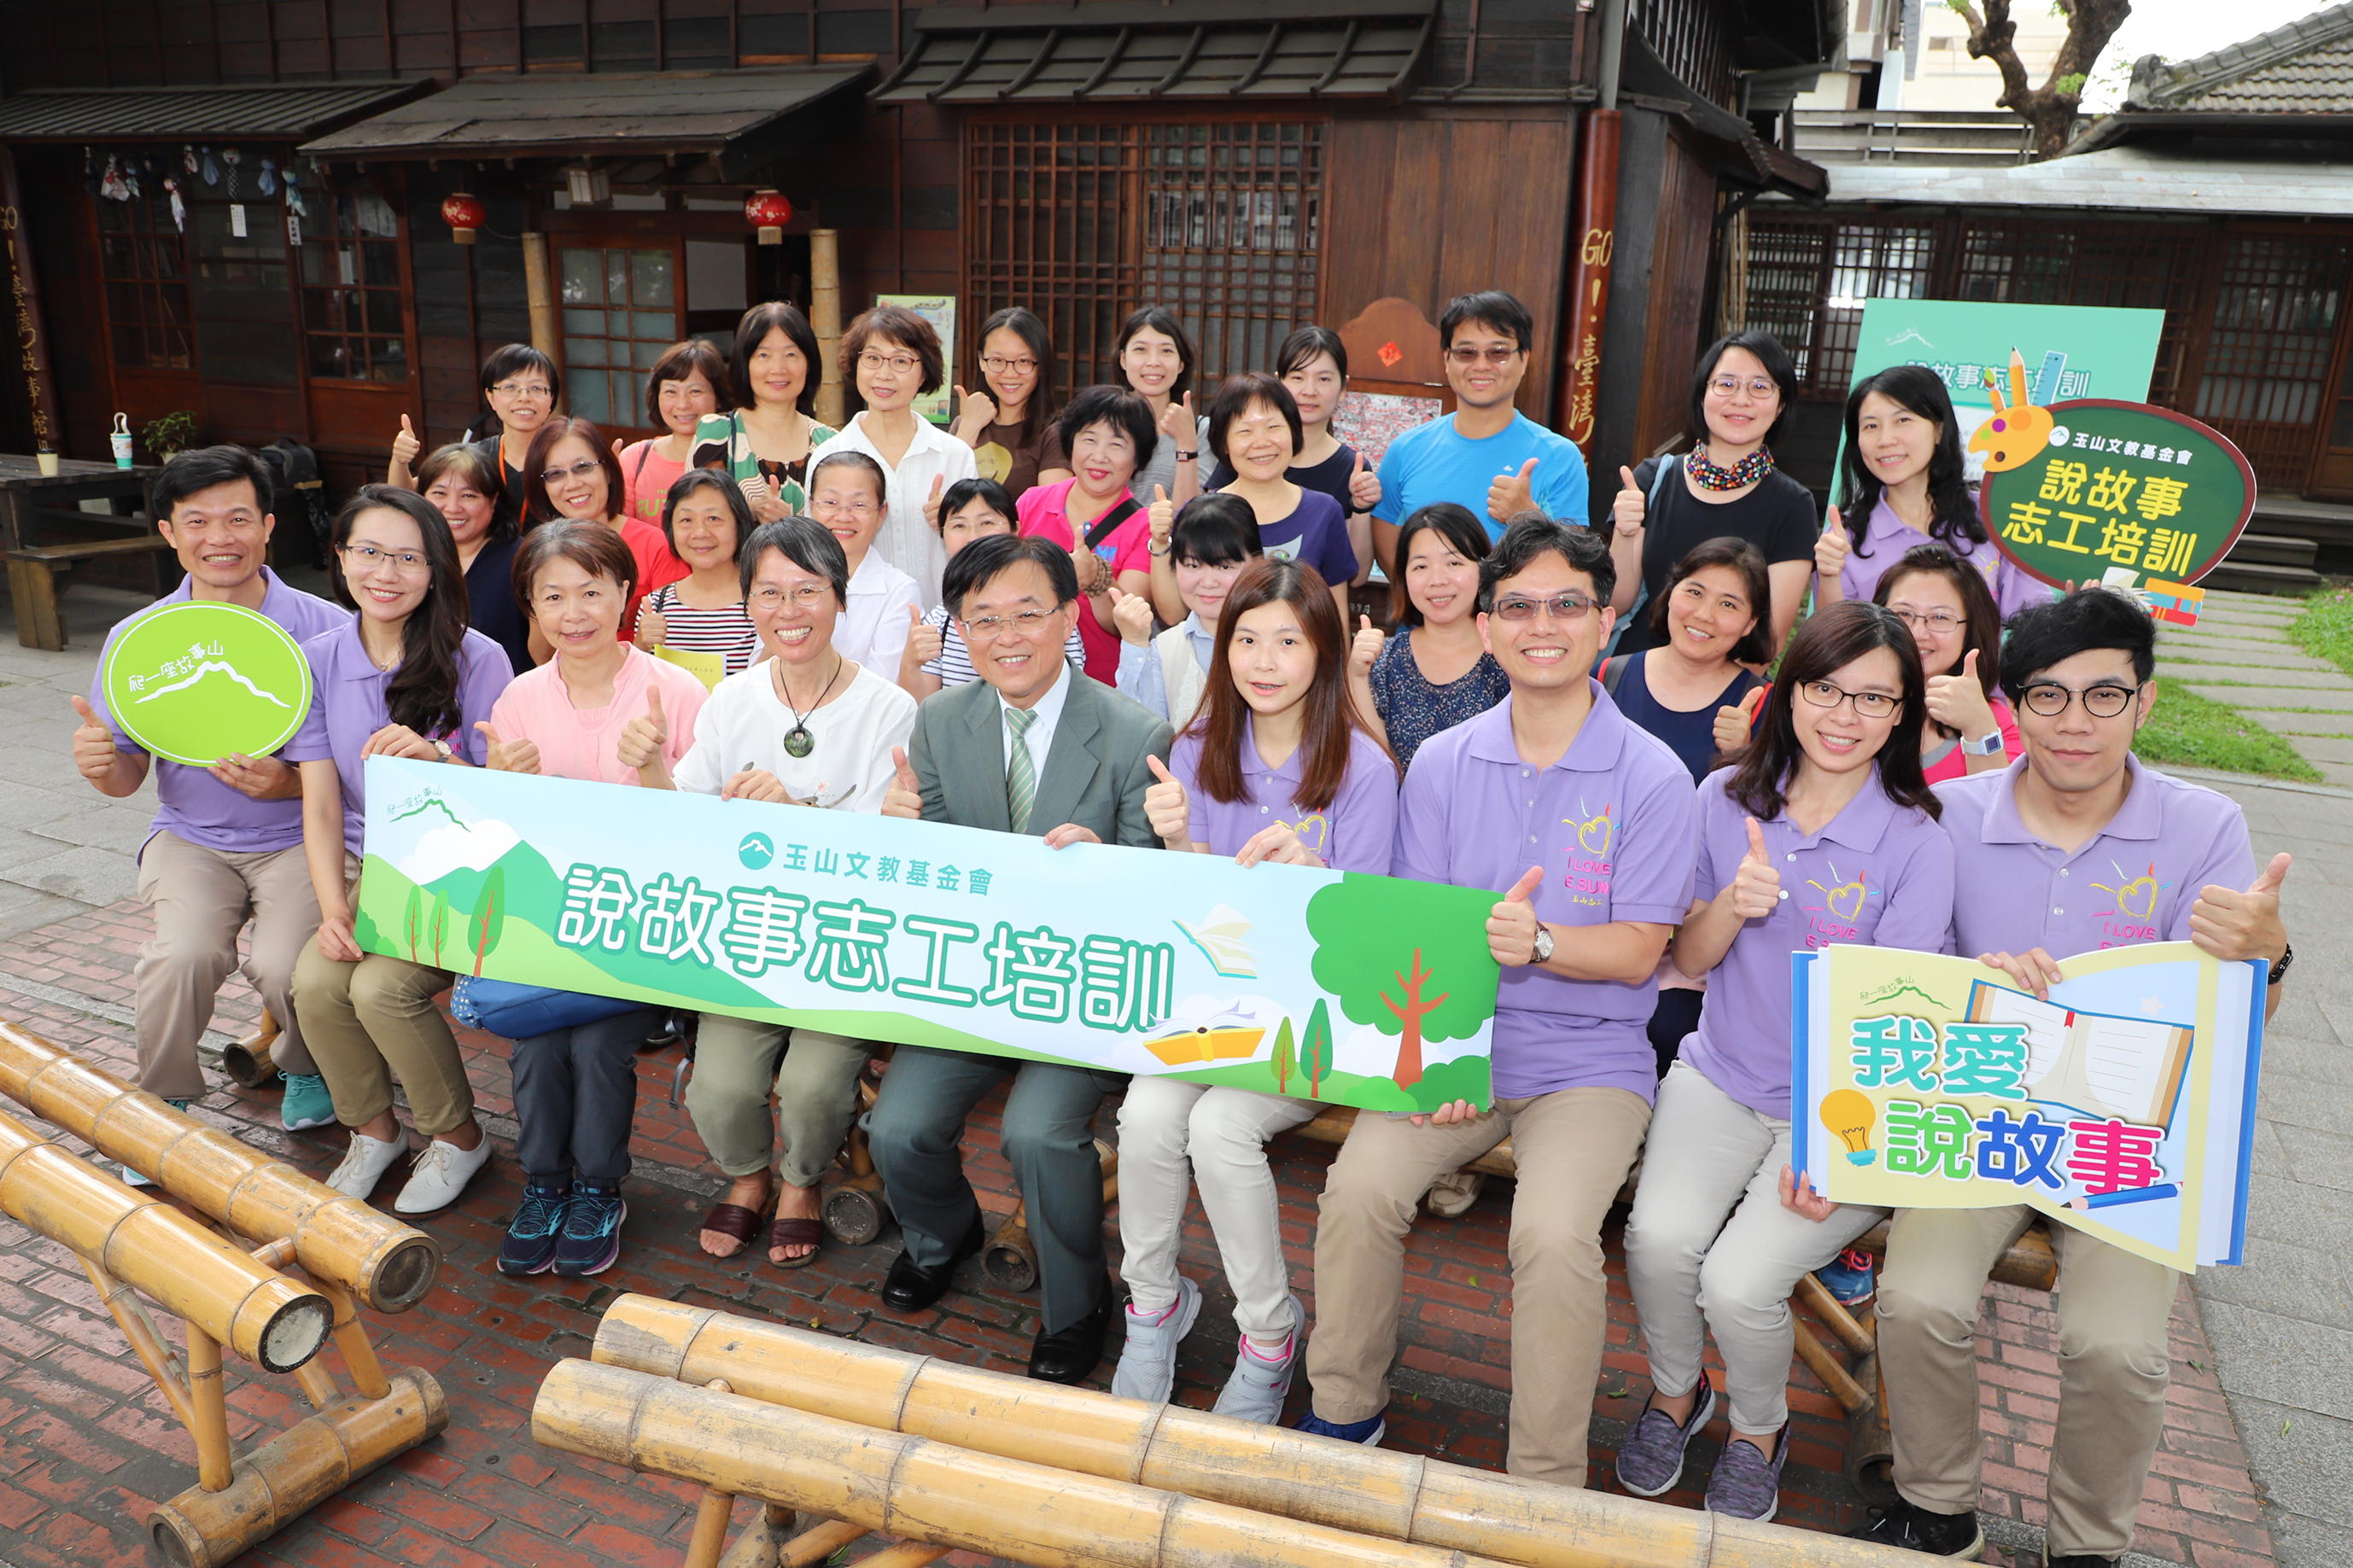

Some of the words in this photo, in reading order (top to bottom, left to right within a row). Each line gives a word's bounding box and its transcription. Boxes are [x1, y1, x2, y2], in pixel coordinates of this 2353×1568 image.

[1569, 334, 1600, 467] 臺灣
[2072, 432, 2193, 466] 玉山文教基金會
[2039, 458, 2189, 521] 說故事
[2001, 501, 2198, 577] 志工培訓
[129, 639, 224, 692] 爬一座故事山
[387, 785, 443, 815] 爬一座故事山
[783, 843, 993, 896] 玉山文教基金會
[1564, 875, 1610, 895] E.SUN
[1568, 856, 1573, 868] I
[1573, 858, 1613, 876] LOVE
[554, 864, 1174, 1032] 說故事志工培訓
[1810, 916, 1817, 929] I
[1818, 919, 1860, 940] LOVE
[2104, 922, 2110, 935] I
[2113, 924, 2157, 941] LOVE
[1860, 976, 1915, 1000] 爬一座故事山
[1849, 1015, 2030, 1101] 我愛
[1883, 1100, 2166, 1195] 說故事
